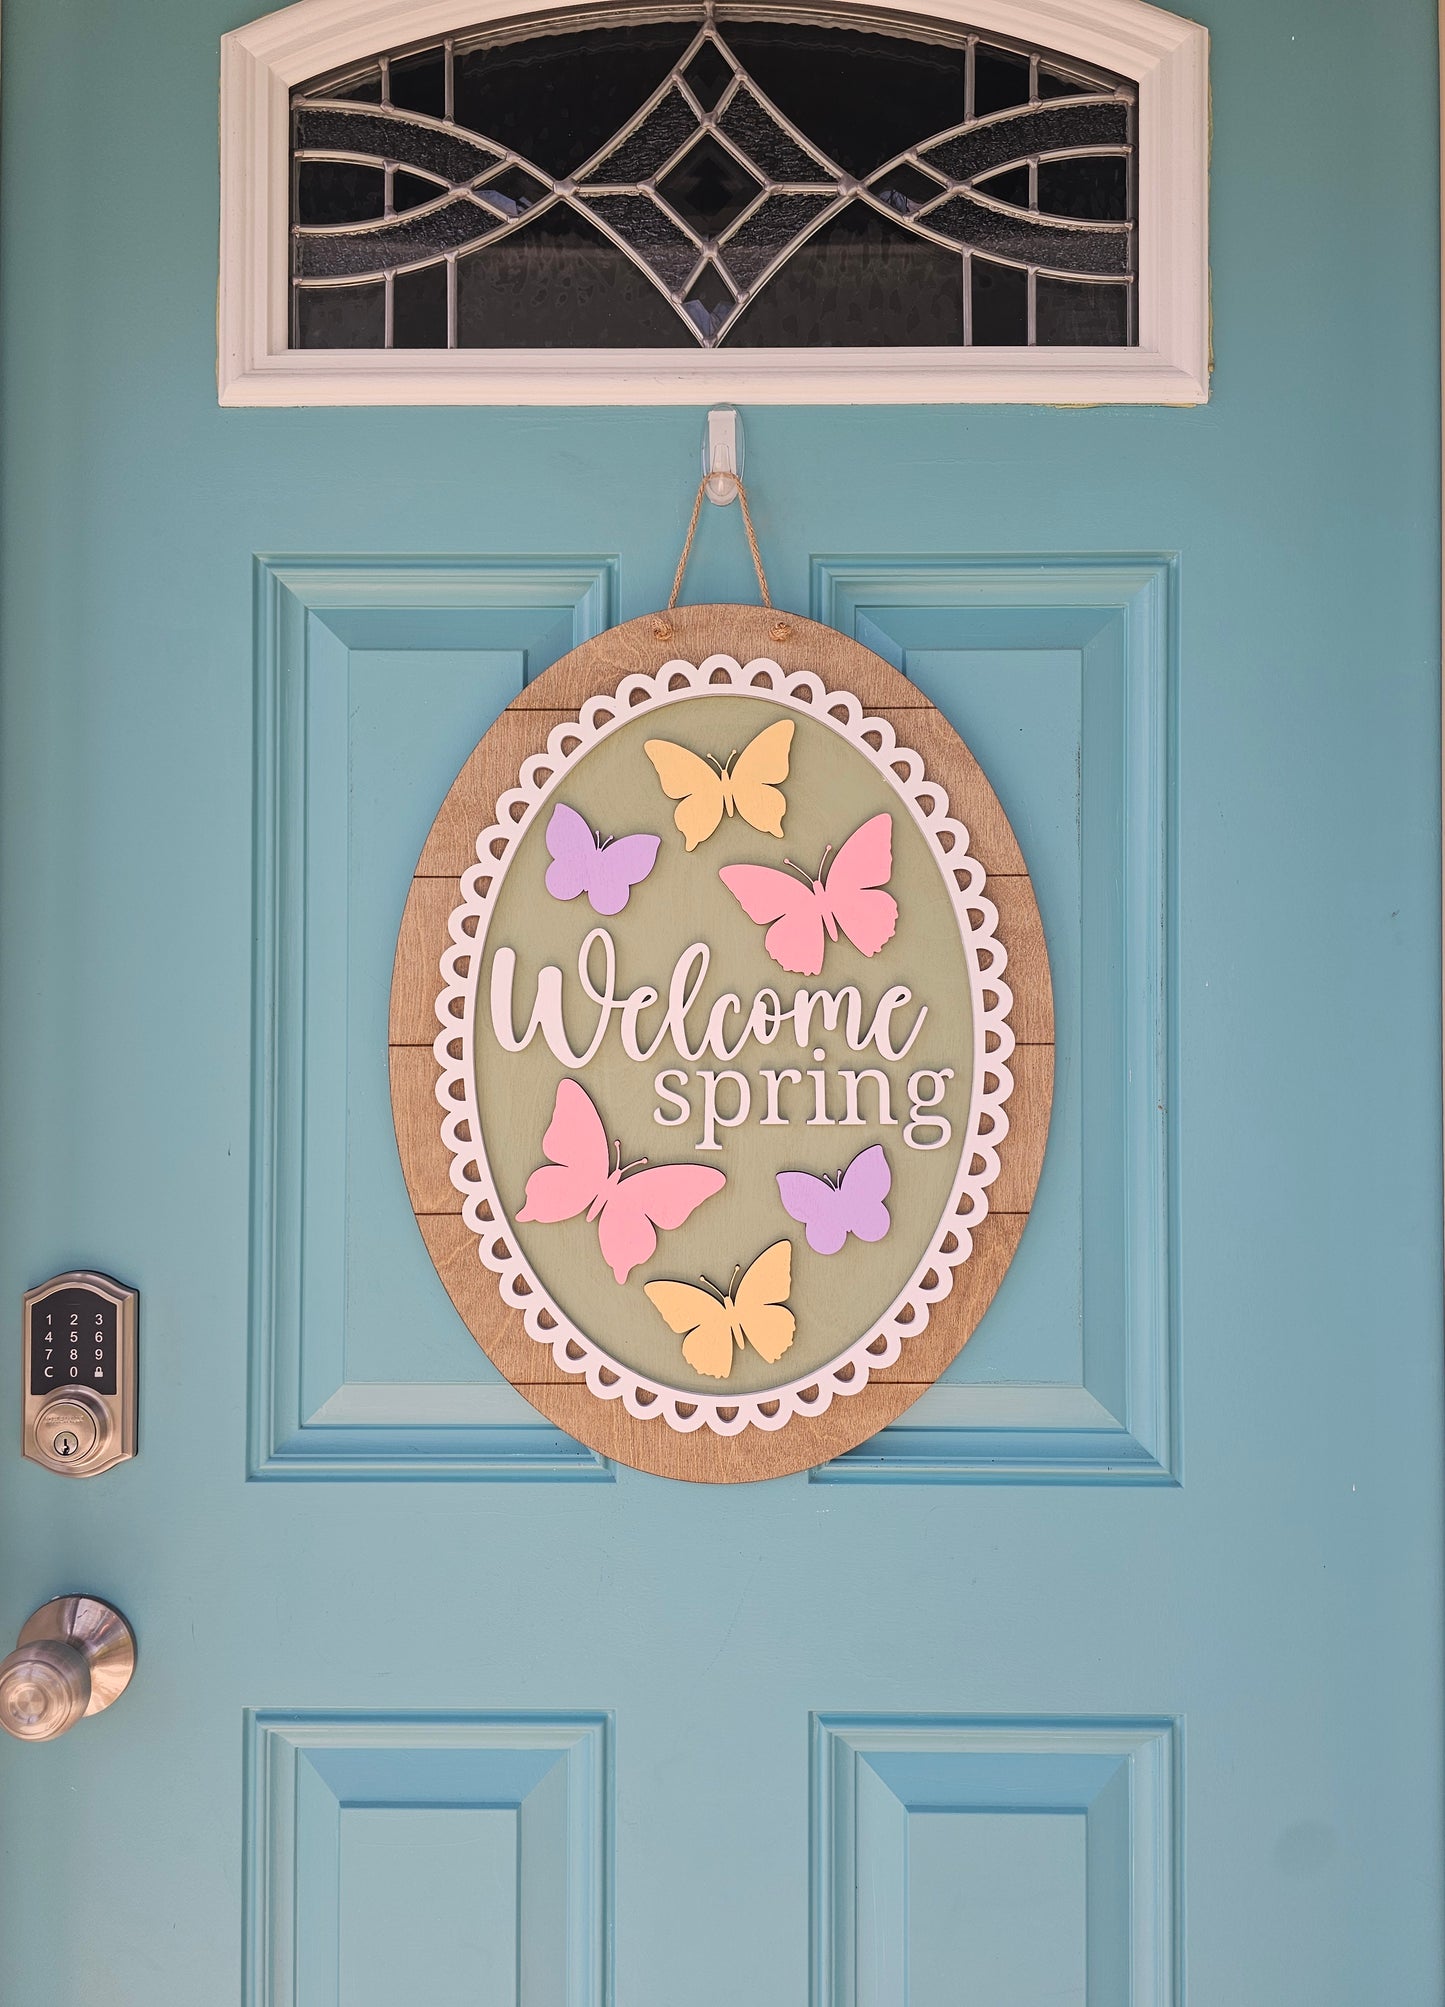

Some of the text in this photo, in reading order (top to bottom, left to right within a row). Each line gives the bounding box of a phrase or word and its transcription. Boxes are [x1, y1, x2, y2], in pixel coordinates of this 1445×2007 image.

[490, 927, 928, 1068] Welcome
[653, 1048, 954, 1150] spring
[70, 1314, 78, 1326] 2
[95, 1314, 103, 1326] 3
[44, 1331, 103, 1343] 4 5 6
[45, 1349, 103, 1360] 7 8 9
[44, 1366, 78, 1378] C 0
